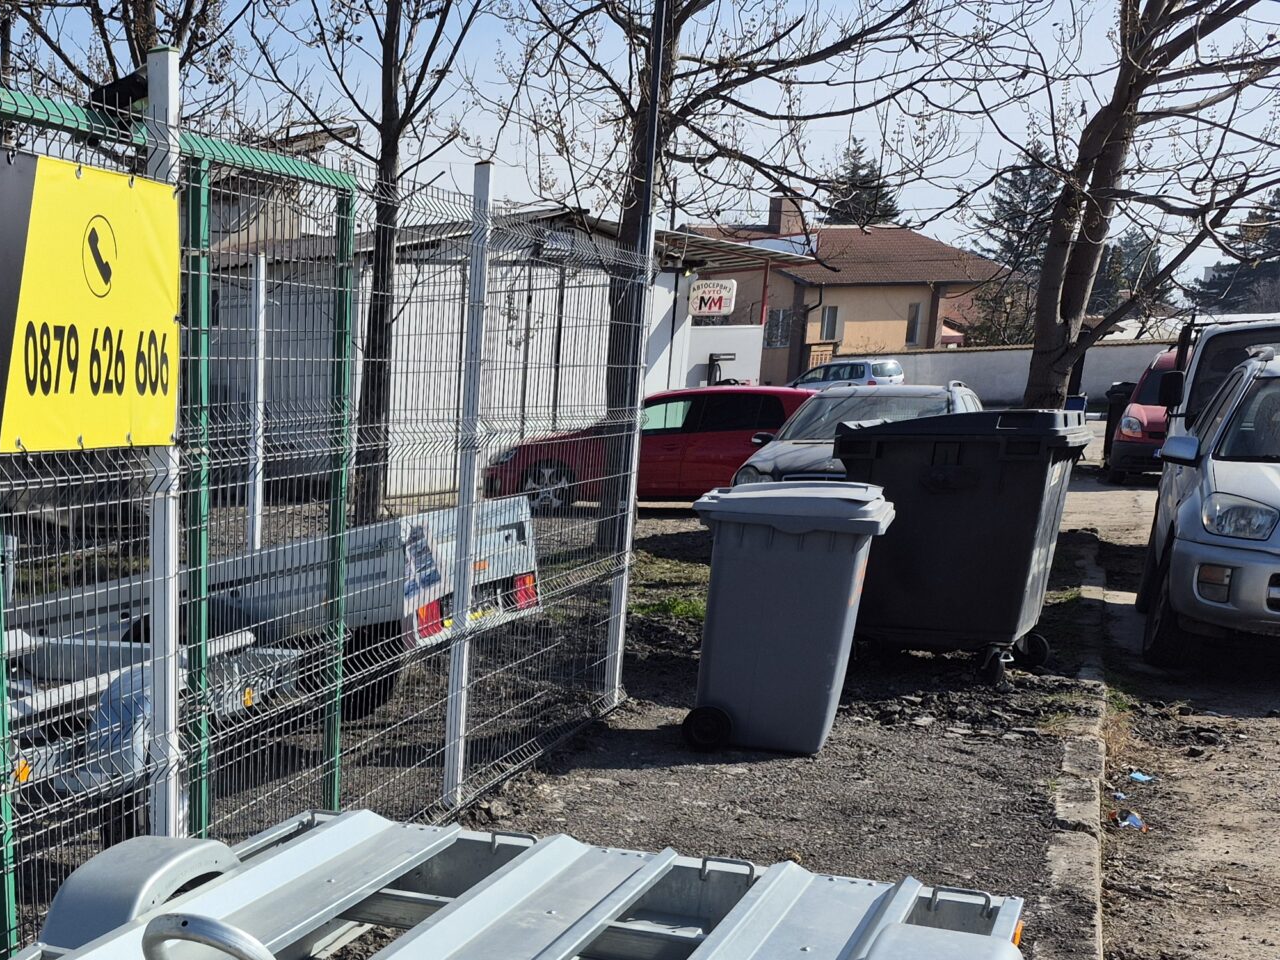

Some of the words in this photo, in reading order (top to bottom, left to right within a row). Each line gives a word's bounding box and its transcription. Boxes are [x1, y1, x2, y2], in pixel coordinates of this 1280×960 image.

[24, 320, 79, 397] 0879
[90, 327, 126, 397] 626
[135, 330, 169, 397] 606
